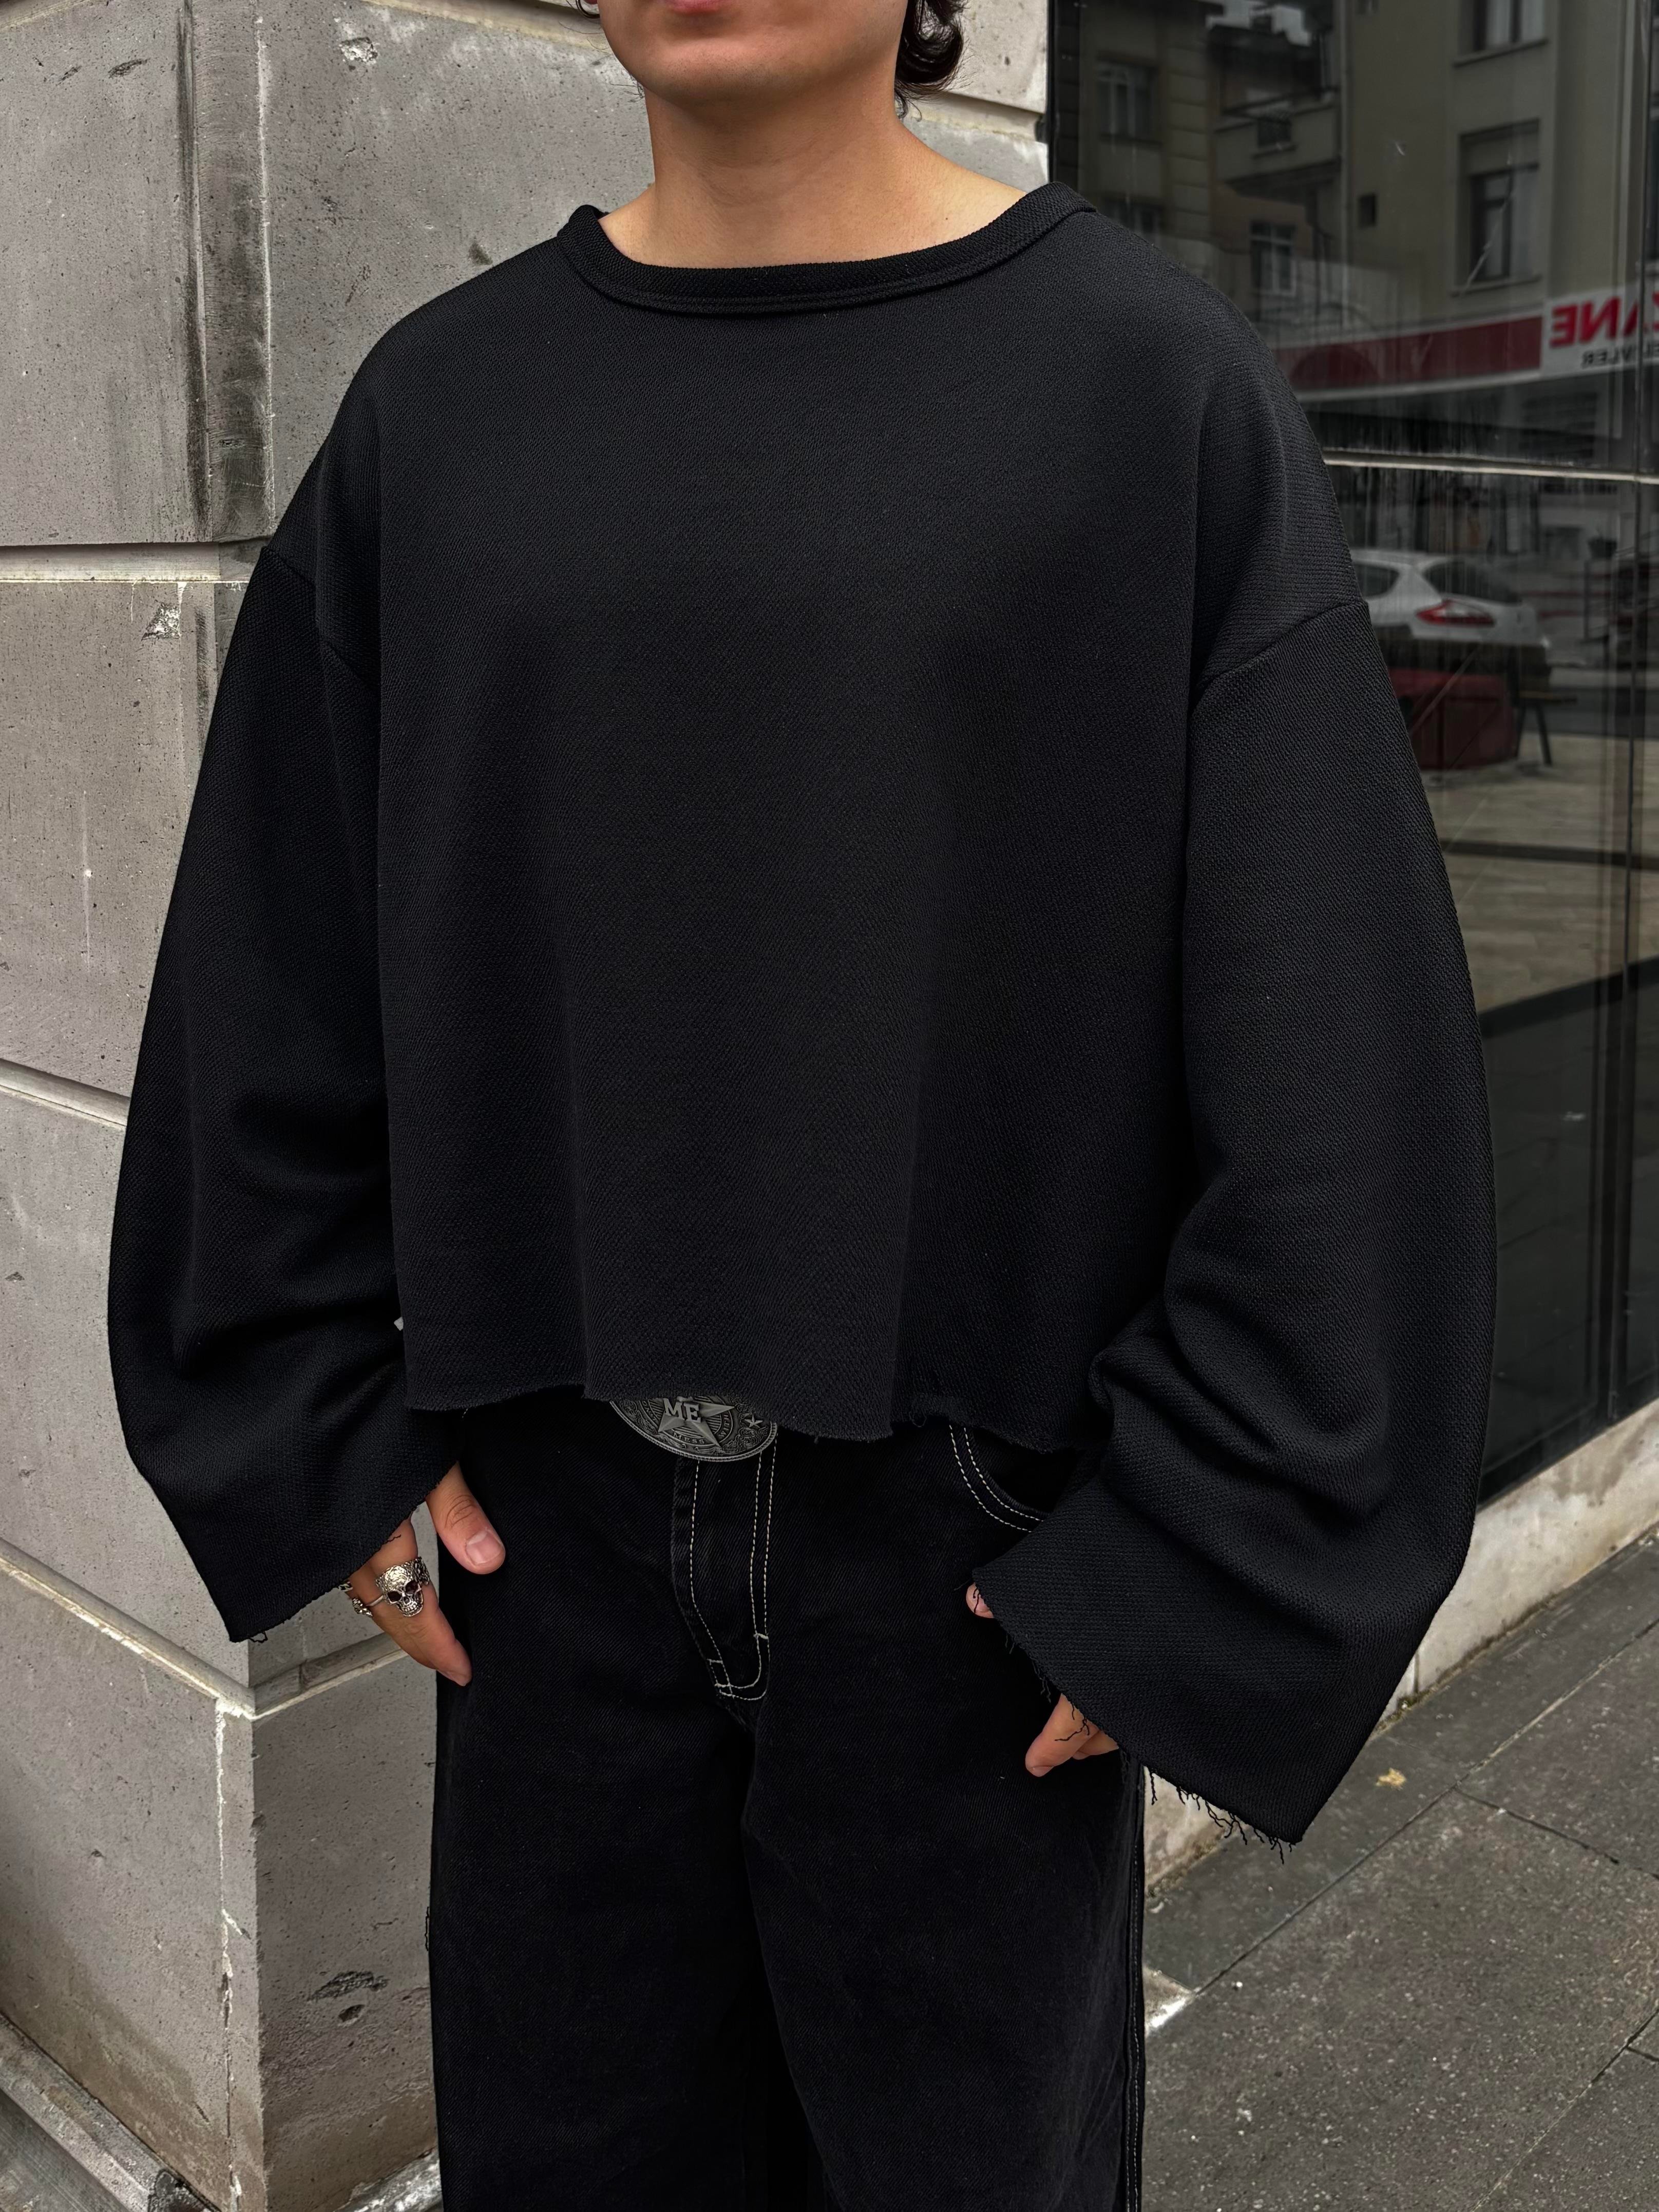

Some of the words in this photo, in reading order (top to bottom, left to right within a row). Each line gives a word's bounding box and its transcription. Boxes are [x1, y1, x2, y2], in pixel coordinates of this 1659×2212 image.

[663, 1398, 701, 1423] ME
[673, 1432, 705, 1444] MESS
[719, 1413, 730, 1437] WITH
